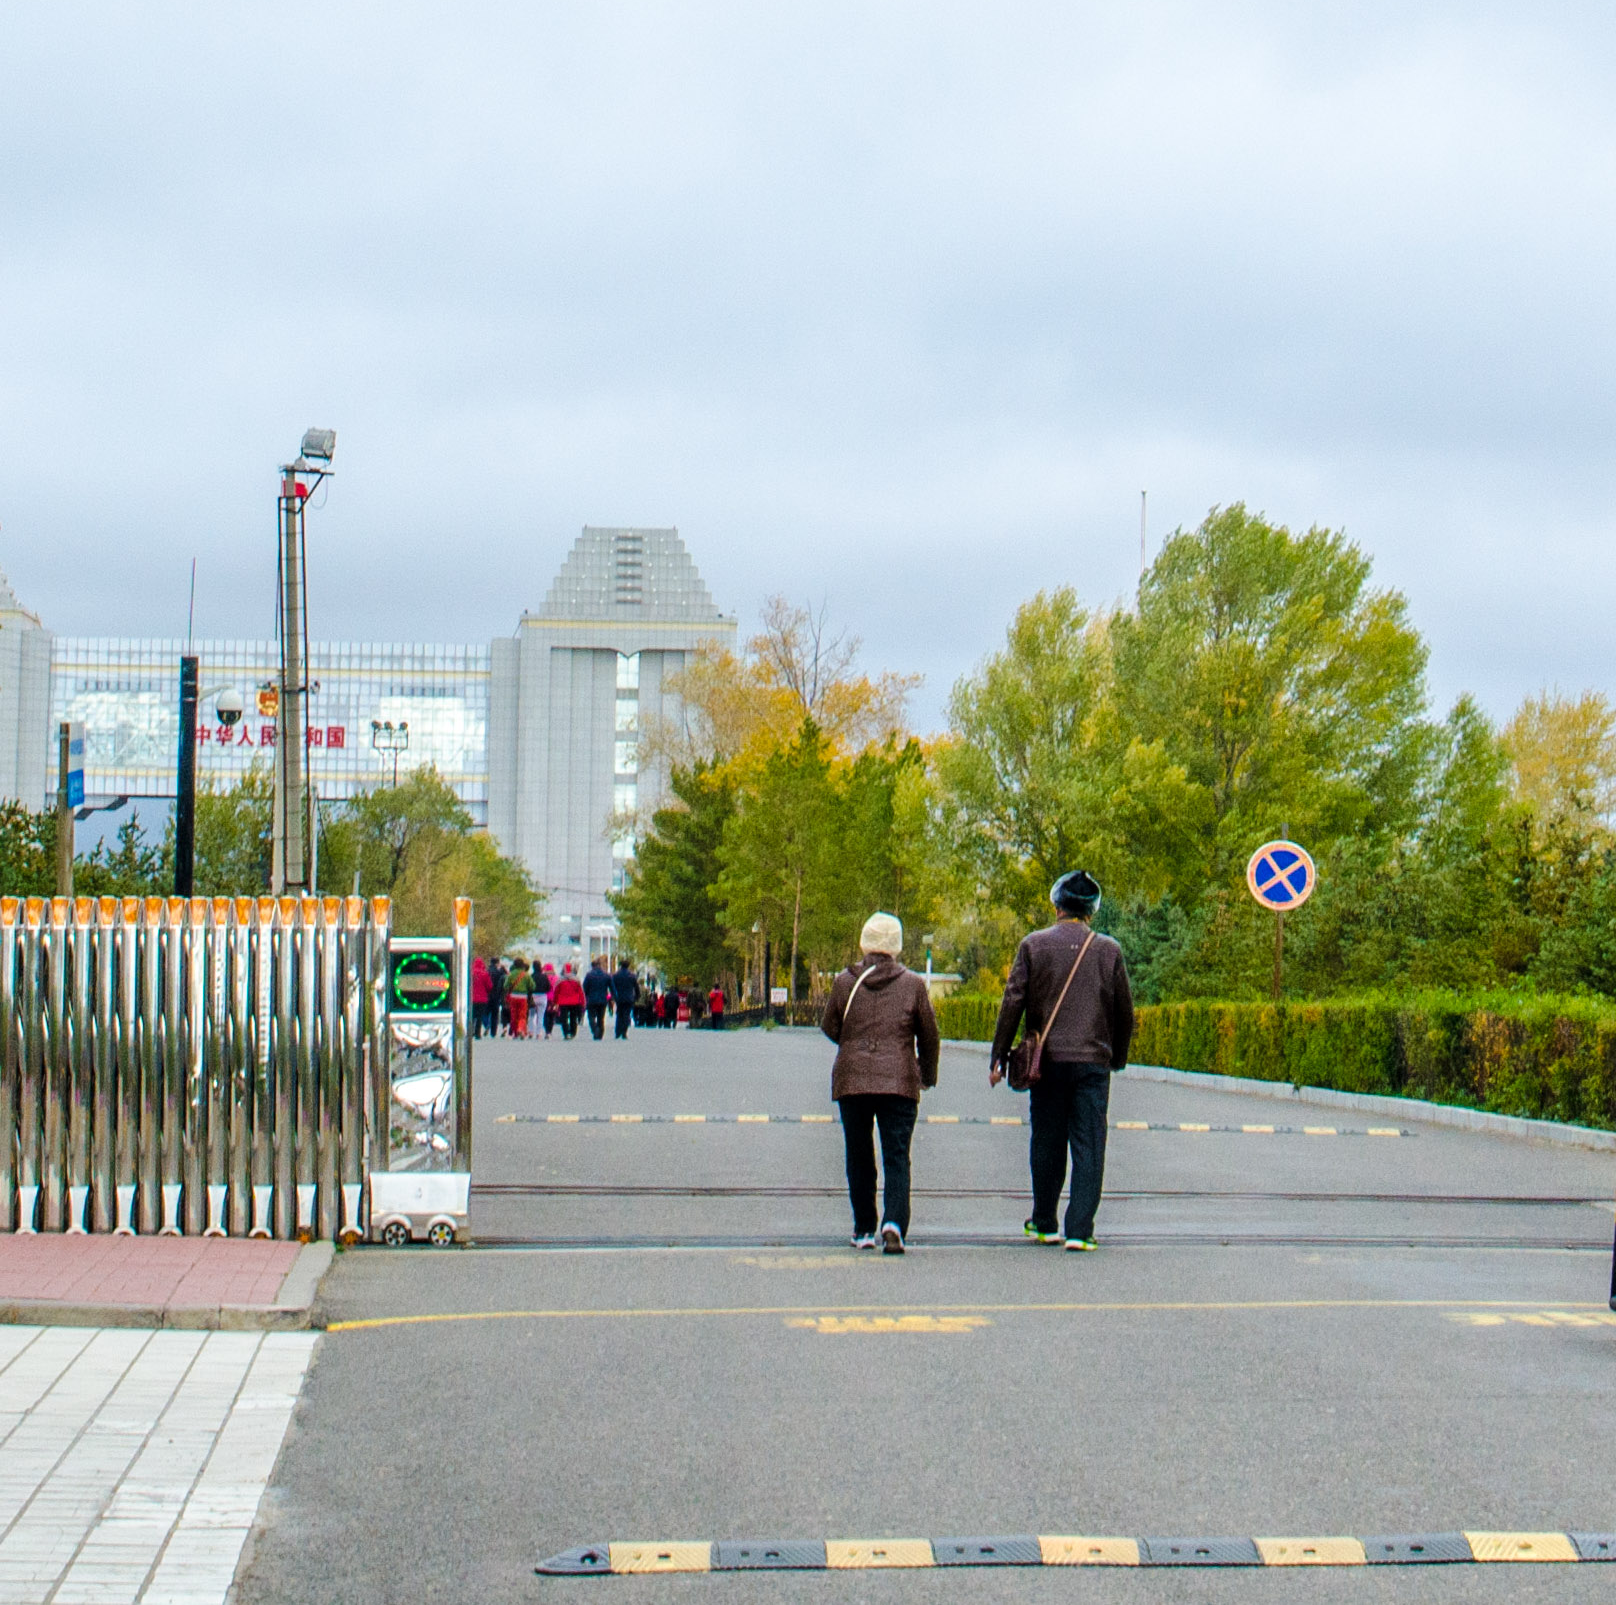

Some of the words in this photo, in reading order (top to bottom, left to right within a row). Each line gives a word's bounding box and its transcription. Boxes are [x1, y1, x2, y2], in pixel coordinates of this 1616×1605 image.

[195, 724, 345, 748] 中华人民和国
